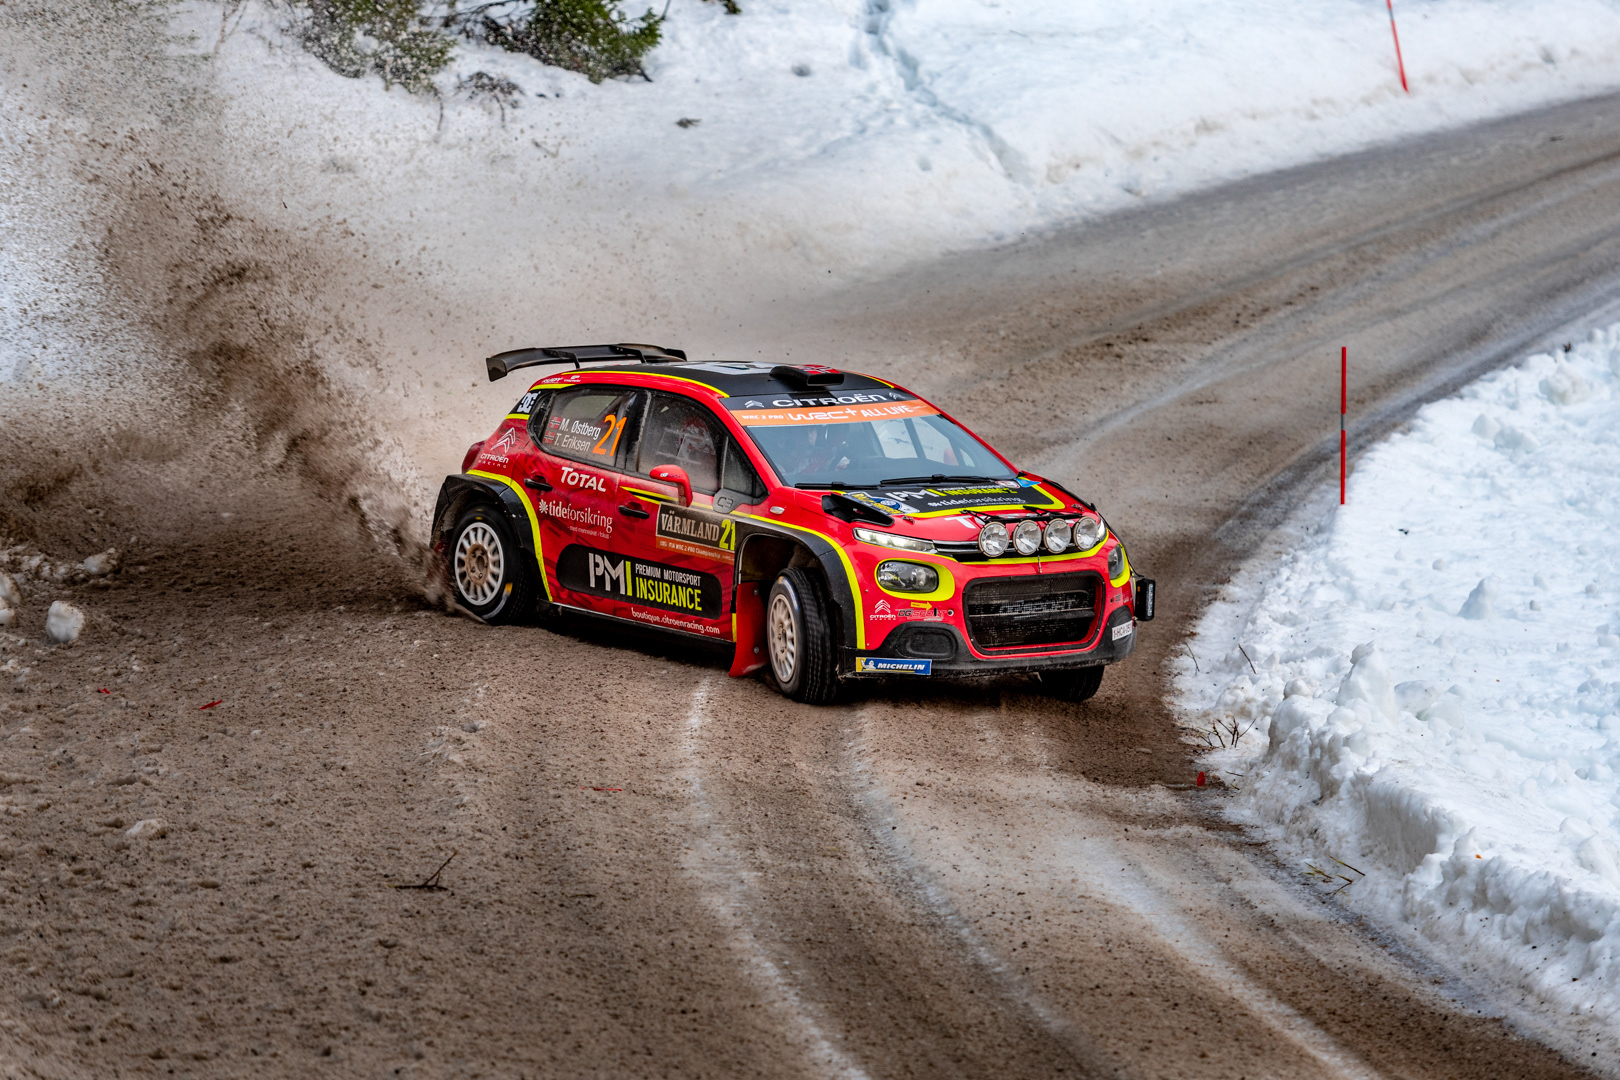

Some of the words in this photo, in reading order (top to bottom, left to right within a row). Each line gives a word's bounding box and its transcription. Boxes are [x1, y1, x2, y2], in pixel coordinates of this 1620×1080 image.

[773, 393, 887, 407] CITROËN
[862, 408, 882, 418] ALL
[884, 405, 913, 416] LIVE
[559, 418, 569, 432] M.
[571, 421, 601, 441] Østberg
[592, 414, 628, 457] 21
[554, 434, 561, 446] T.
[561, 435, 591, 452] Eriksen
[480, 452, 509, 463] CITROËN
[560, 466, 606, 492] TOTAL
[548, 500, 613, 534] tideforsikring
[661, 510, 720, 542] VÄRMLAND
[718, 518, 736, 551] 21
[588, 552, 633, 596] PMI
[635, 563, 661, 579] PREMIUM
[663, 569, 701, 587] MOTORSPORT
[635, 576, 702, 611] INSURANCE
[631, 606, 720, 634] boutique.citroenracing.com
[877, 662, 925, 670] MICHELIN
